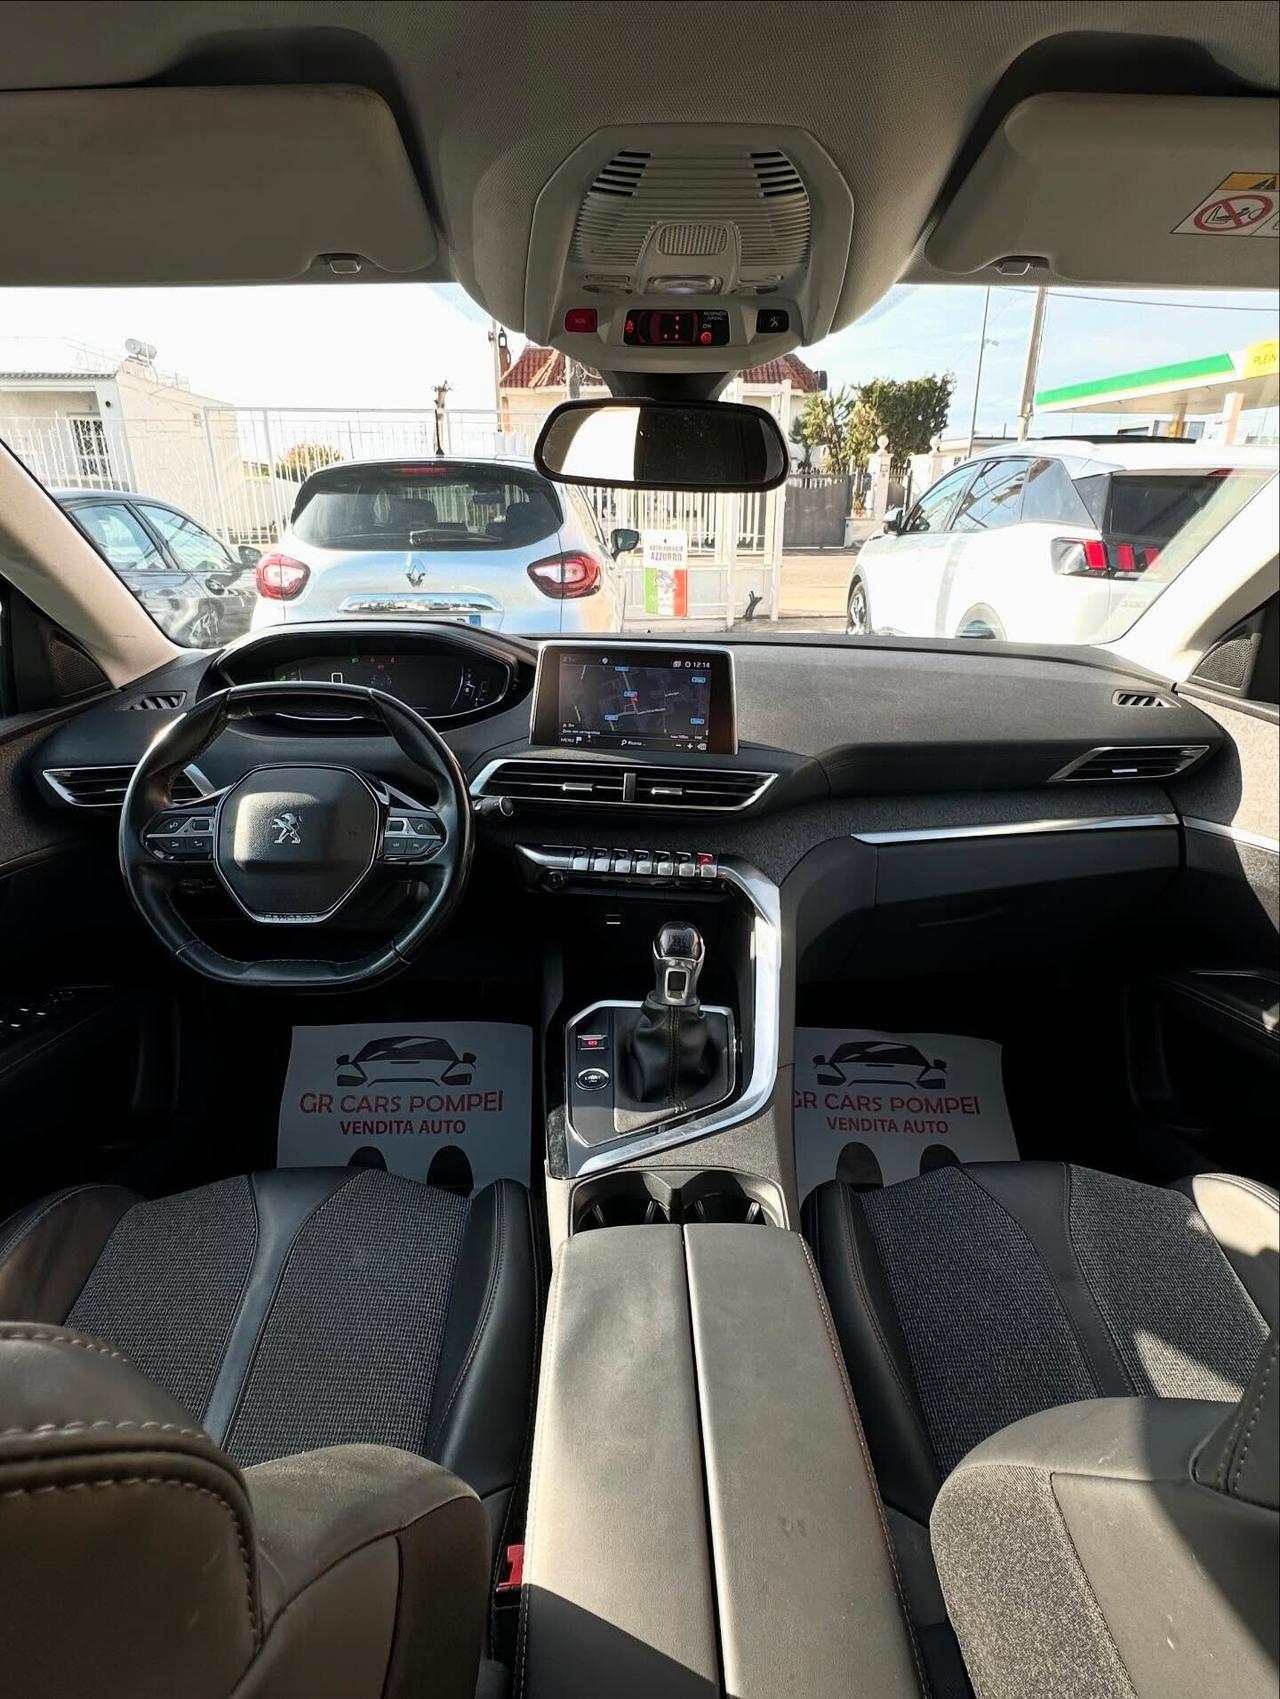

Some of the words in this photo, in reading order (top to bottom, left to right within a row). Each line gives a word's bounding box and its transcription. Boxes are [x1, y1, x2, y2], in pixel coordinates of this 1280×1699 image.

[650, 552, 683, 562] AZZURRO
[692, 661, 711, 669] 12:14
[300, 1092, 333, 1114] GR
[340, 1095, 401, 1113] CARS
[409, 1090, 504, 1113] POMPEI
[824, 1092, 882, 1111] CARS
[890, 1095, 981, 1115] POMPEI
[340, 1119, 414, 1135] VENDITA
[418, 1119, 467, 1135] AUTO
[826, 1117, 899, 1133] VENDITA
[903, 1119, 949, 1135] AUTO
